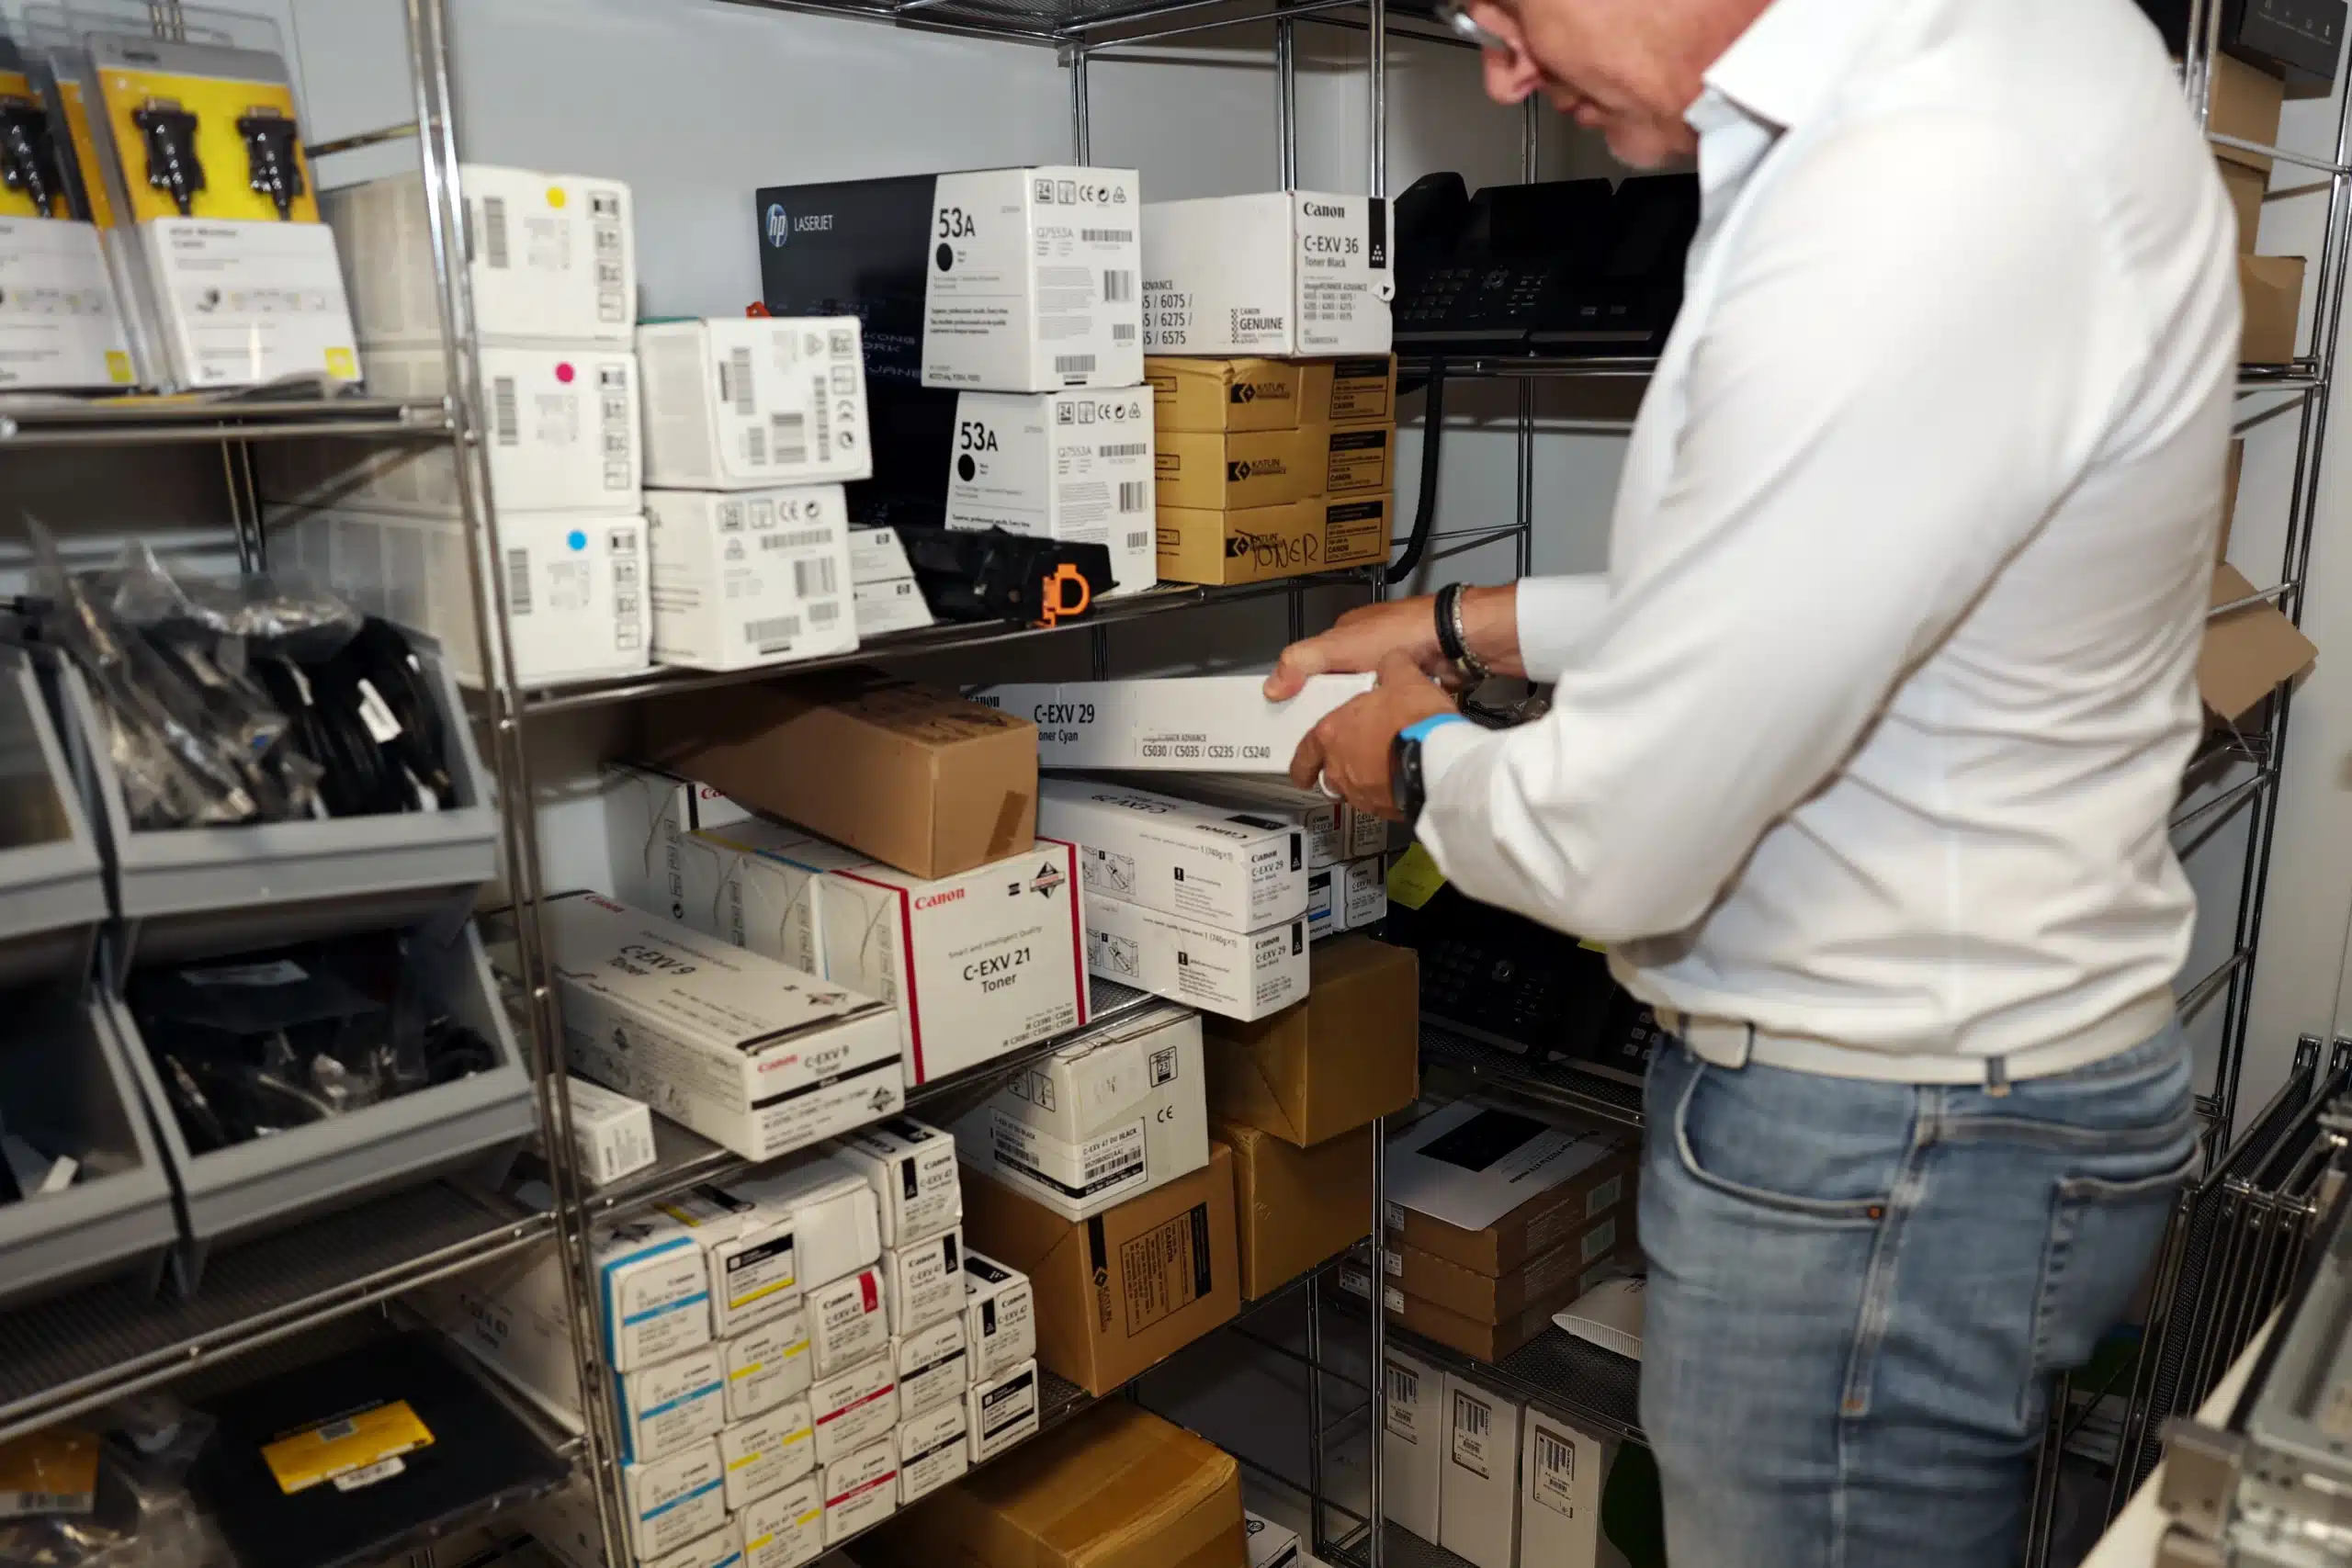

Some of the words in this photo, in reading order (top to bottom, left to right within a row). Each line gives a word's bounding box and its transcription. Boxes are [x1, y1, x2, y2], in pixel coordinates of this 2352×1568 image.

[1304, 201, 1345, 219] Canon
[769, 204, 786, 247] hp
[794, 215, 834, 231] LASERJET
[939, 208, 976, 238] 53A
[1305, 235, 1341, 253] C-EXV
[1345, 237, 1359, 254] 36
[1305, 256, 1325, 268] Toner
[1328, 256, 1346, 268] Black
[1160, 294, 1185, 309] 6075
[1160, 312, 1185, 326] 6275
[1239, 317, 1283, 330] GENUINE
[1162, 331, 1186, 344] 6575
[961, 422, 999, 452] 53A
[1235, 529, 1318, 571] TONER
[1035, 704, 1075, 724] C-EXV
[1079, 704, 1094, 724] 29
[1037, 731, 1057, 741] oner
[1058, 729, 1078, 744] Cyan
[1143, 745, 1167, 758] C5030
[1175, 745, 1200, 758] C5035
[1208, 745, 1233, 758] C5235
[1242, 746, 1271, 759] C5240
[1251, 851, 1278, 863] Canon
[1252, 863, 1274, 876] C-EXV
[915, 888, 965, 910] Canon
[1255, 935, 1281, 950] Canon
[964, 953, 1011, 981] C-EXV
[1014, 947, 1031, 965] 21
[981, 973, 1017, 994] Toner
[758, 1055, 798, 1073] Canon
[1158, 1062, 1169, 1073] 23
[1119, 1127, 1137, 1142] BLACK
[923, 1156, 952, 1170] Canon
[908, 1253, 936, 1268] Canon
[823, 1292, 854, 1309] Canon
[1001, 1292, 1027, 1308] Canon
